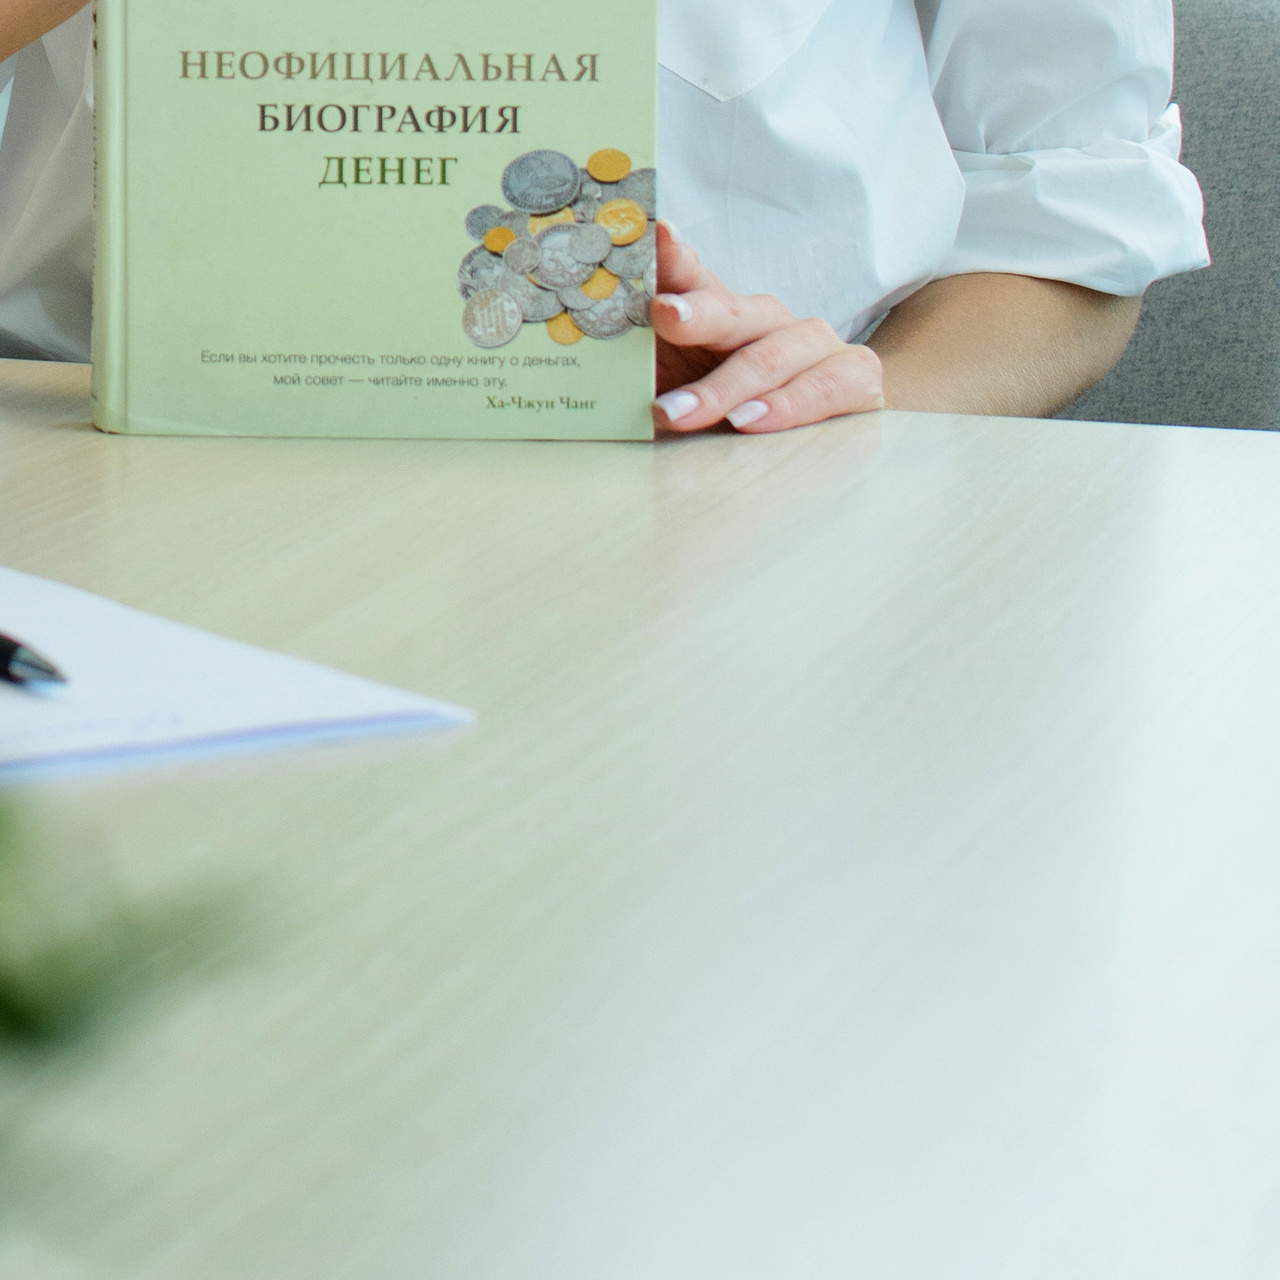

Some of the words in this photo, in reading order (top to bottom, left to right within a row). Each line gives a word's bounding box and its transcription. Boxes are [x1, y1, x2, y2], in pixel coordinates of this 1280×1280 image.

[180, 50, 598, 84] НЕОФИЦИАЛЬНАЯ
[258, 103, 519, 134] БИОГРАФИЯ
[318, 156, 458, 188] ДЕНЕГ
[200, 349, 235, 364] Если
[238, 353, 257, 364] вы
[260, 353, 307, 365] хотите
[310, 353, 376, 367] прочесть
[380, 354, 427, 366] только
[430, 355, 463, 369] одну
[467, 355, 506, 368] книгу
[509, 356, 519, 366] о
[521, 355, 582, 369] деньгах,
[273, 373, 302, 386] мой
[304, 375, 345, 387] совет
[367, 374, 423, 387] читайте
[426, 376, 480, 388] именно
[483, 376, 508, 390] эту.
[486, 395, 555, 413] Ха-Чжун
[559, 396, 596, 410] Чанг
